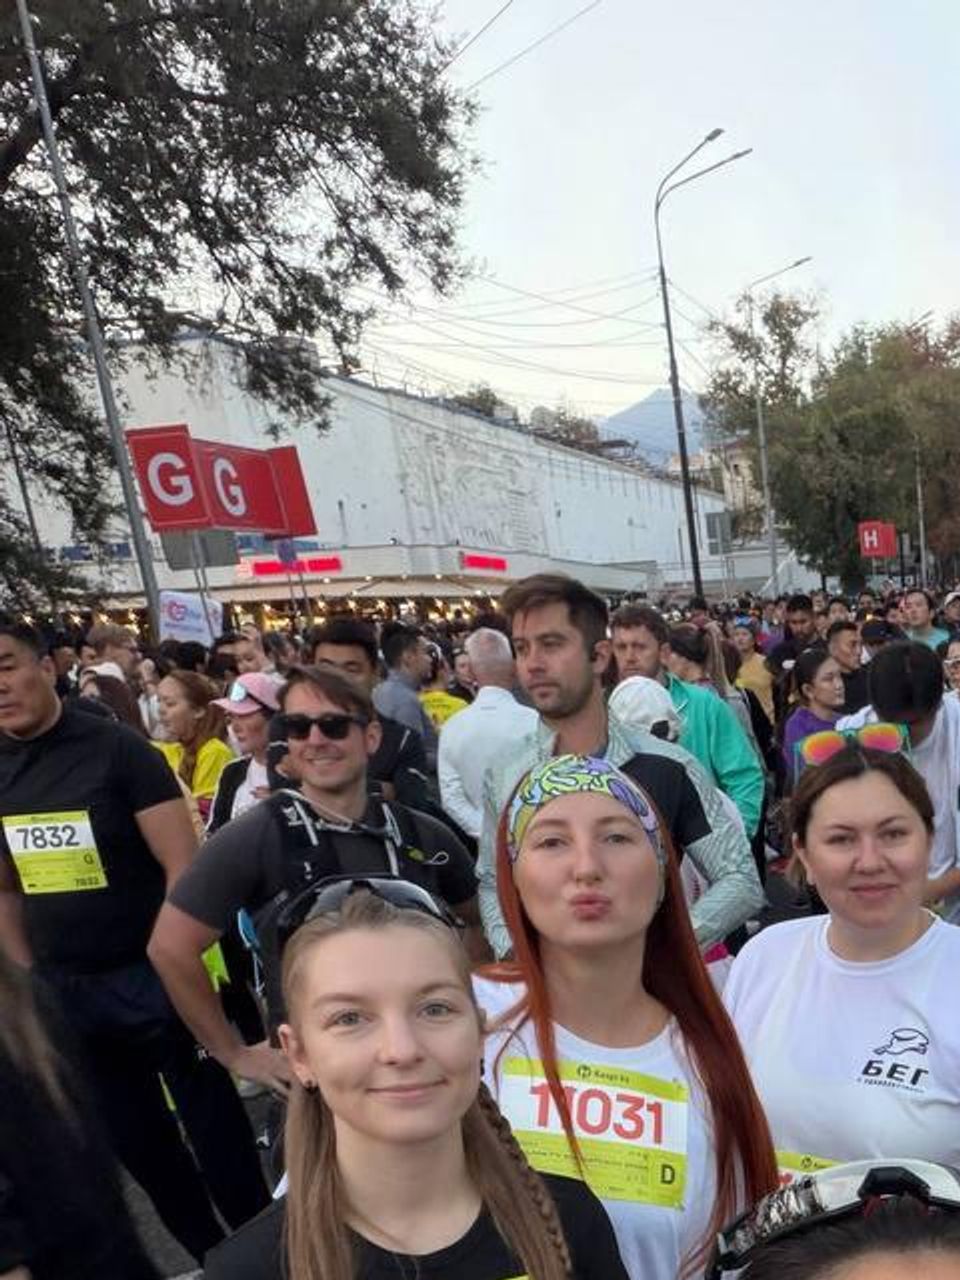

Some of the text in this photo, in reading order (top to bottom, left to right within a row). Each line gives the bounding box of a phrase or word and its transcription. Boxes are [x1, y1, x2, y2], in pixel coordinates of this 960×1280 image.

[147, 452, 194, 506] G
[213, 457, 247, 517] G
[863, 528, 878, 549] H
[16, 824, 80, 849] 7832
[862, 1059, 929, 1085] БЕГ
[530, 1082, 663, 1145] 11031
[660, 1164, 676, 1185] D
